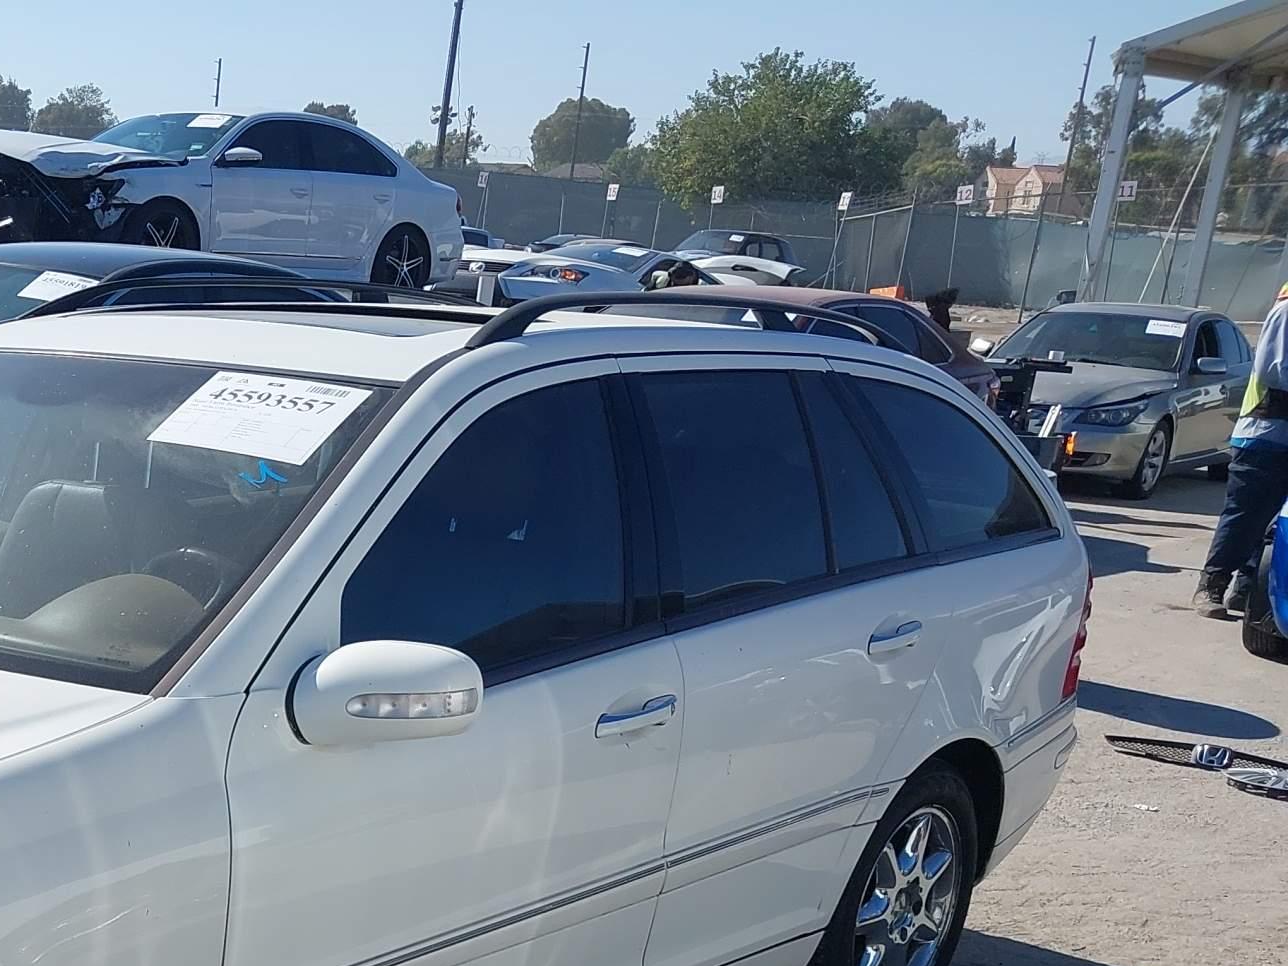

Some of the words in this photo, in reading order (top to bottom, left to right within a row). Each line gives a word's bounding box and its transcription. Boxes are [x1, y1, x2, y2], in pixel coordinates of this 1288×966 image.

[607, 187, 617, 198] 15
[958, 188, 972, 201] 12
[1119, 185, 1135, 198] 11
[209, 387, 336, 415] 45593557
